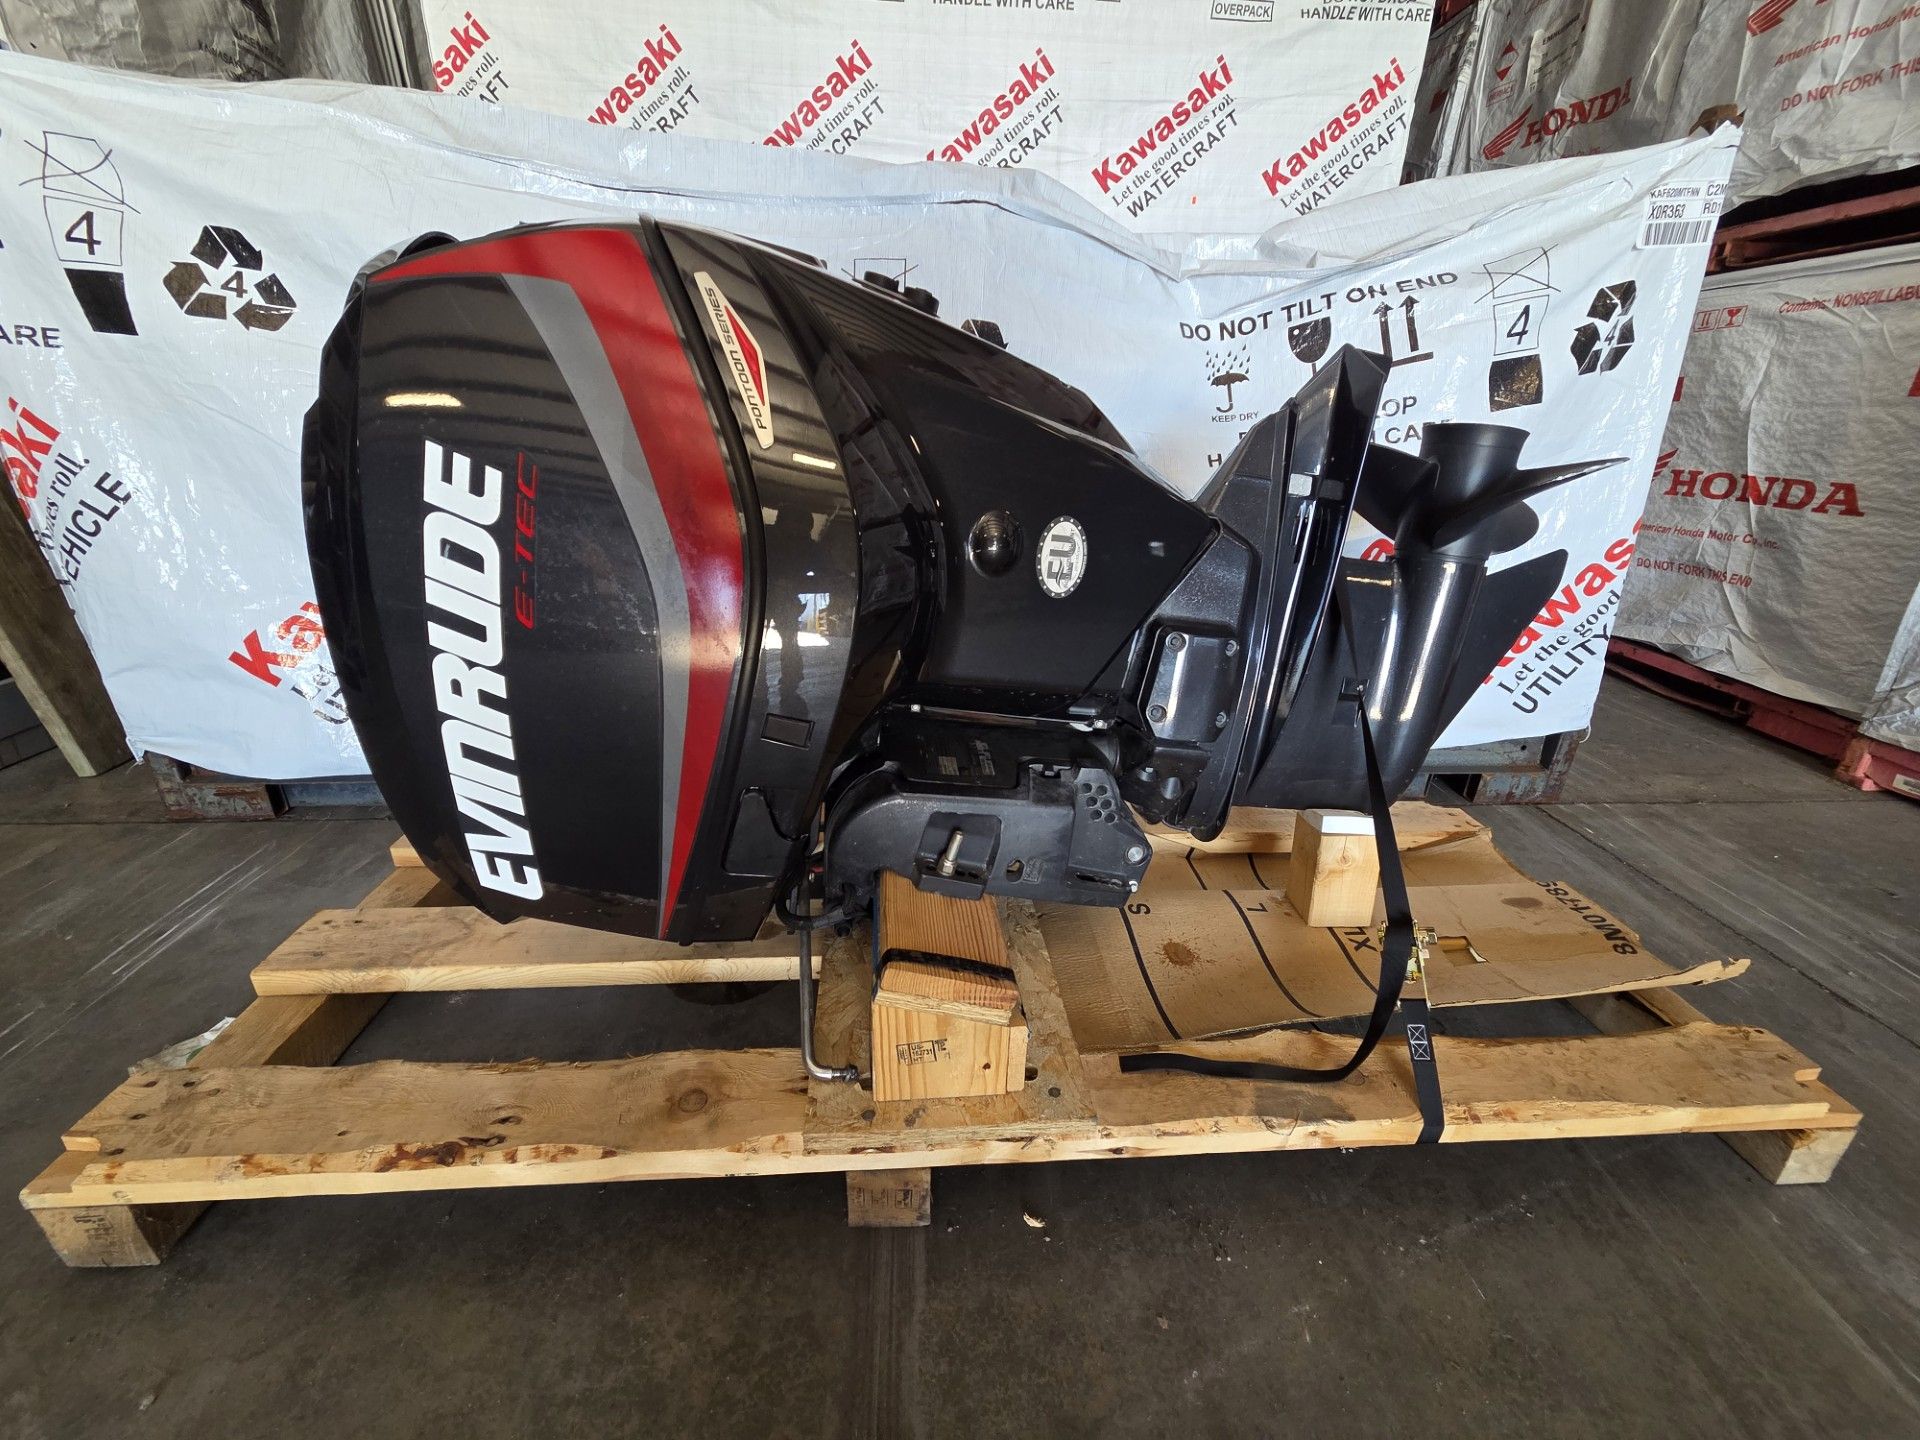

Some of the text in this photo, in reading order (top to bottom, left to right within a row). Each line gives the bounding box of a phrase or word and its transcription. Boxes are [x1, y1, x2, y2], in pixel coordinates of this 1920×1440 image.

[1036, 0, 1075, 11] CARE
[1215, 3, 1271, 18] OVERPACK
[1300, 6, 1431, 22] HANDLE WITH CARE
[432, 11, 491, 93] saki
[475, 52, 499, 79] roll.
[1774, 35, 1842, 67] American
[1845, 14, 1898, 42] Honda
[639, 66, 691, 122] times roll.
[824, 101, 855, 133] times
[853, 78, 879, 105] roll.
[926, 47, 1055, 163] awasaki
[1003, 110, 1036, 143] times
[1035, 88, 1060, 114] roll.
[1781, 93, 1803, 112] DO
[1807, 83, 1838, 103] NOT
[1838, 67, 1886, 95] FORK
[825, 96, 885, 155] CRAFT
[1091, 54, 1233, 194] Kawasaki
[1261, 57, 1406, 197] Kawasaki
[1280, 95, 1408, 208] Let the good times roll.
[1111, 185, 1134, 207] Let
[1132, 167, 1152, 189] the
[1151, 142, 1179, 176] good
[1178, 113, 1211, 148] times
[1126, 108, 1239, 218] WATERCRAFT
[1294, 112, 1408, 217] WATERCRAFT
[65, 210, 102, 256] 4
[220, 271, 249, 299] 4
[1180, 272, 1459, 342] DO NOT TILT ON END
[1506, 304, 1531, 345] 4
[1604, 318, 1619, 347] 4
[704, 287, 768, 430] PONTOON SERIES
[1211, 410, 1260, 423] KEEP DRY
[1375, 395, 1418, 419] OP
[53, 452, 90, 498] roll.
[1664, 468, 1865, 518] HONDA
[515, 451, 539, 630] E-TEC
[1674, 525, 1705, 538] Honda
[1707, 529, 1739, 542] Motor
[1637, 557, 1650, 568] DO
[1653, 560, 1675, 572] NOT
[1678, 563, 1705, 578] FORK
[1708, 567, 1728, 584] THIS
[423, 439, 544, 900] EVINRUDE
[1497, 589, 1621, 695] Let the good
[1511, 622, 1611, 715] UTILITY
